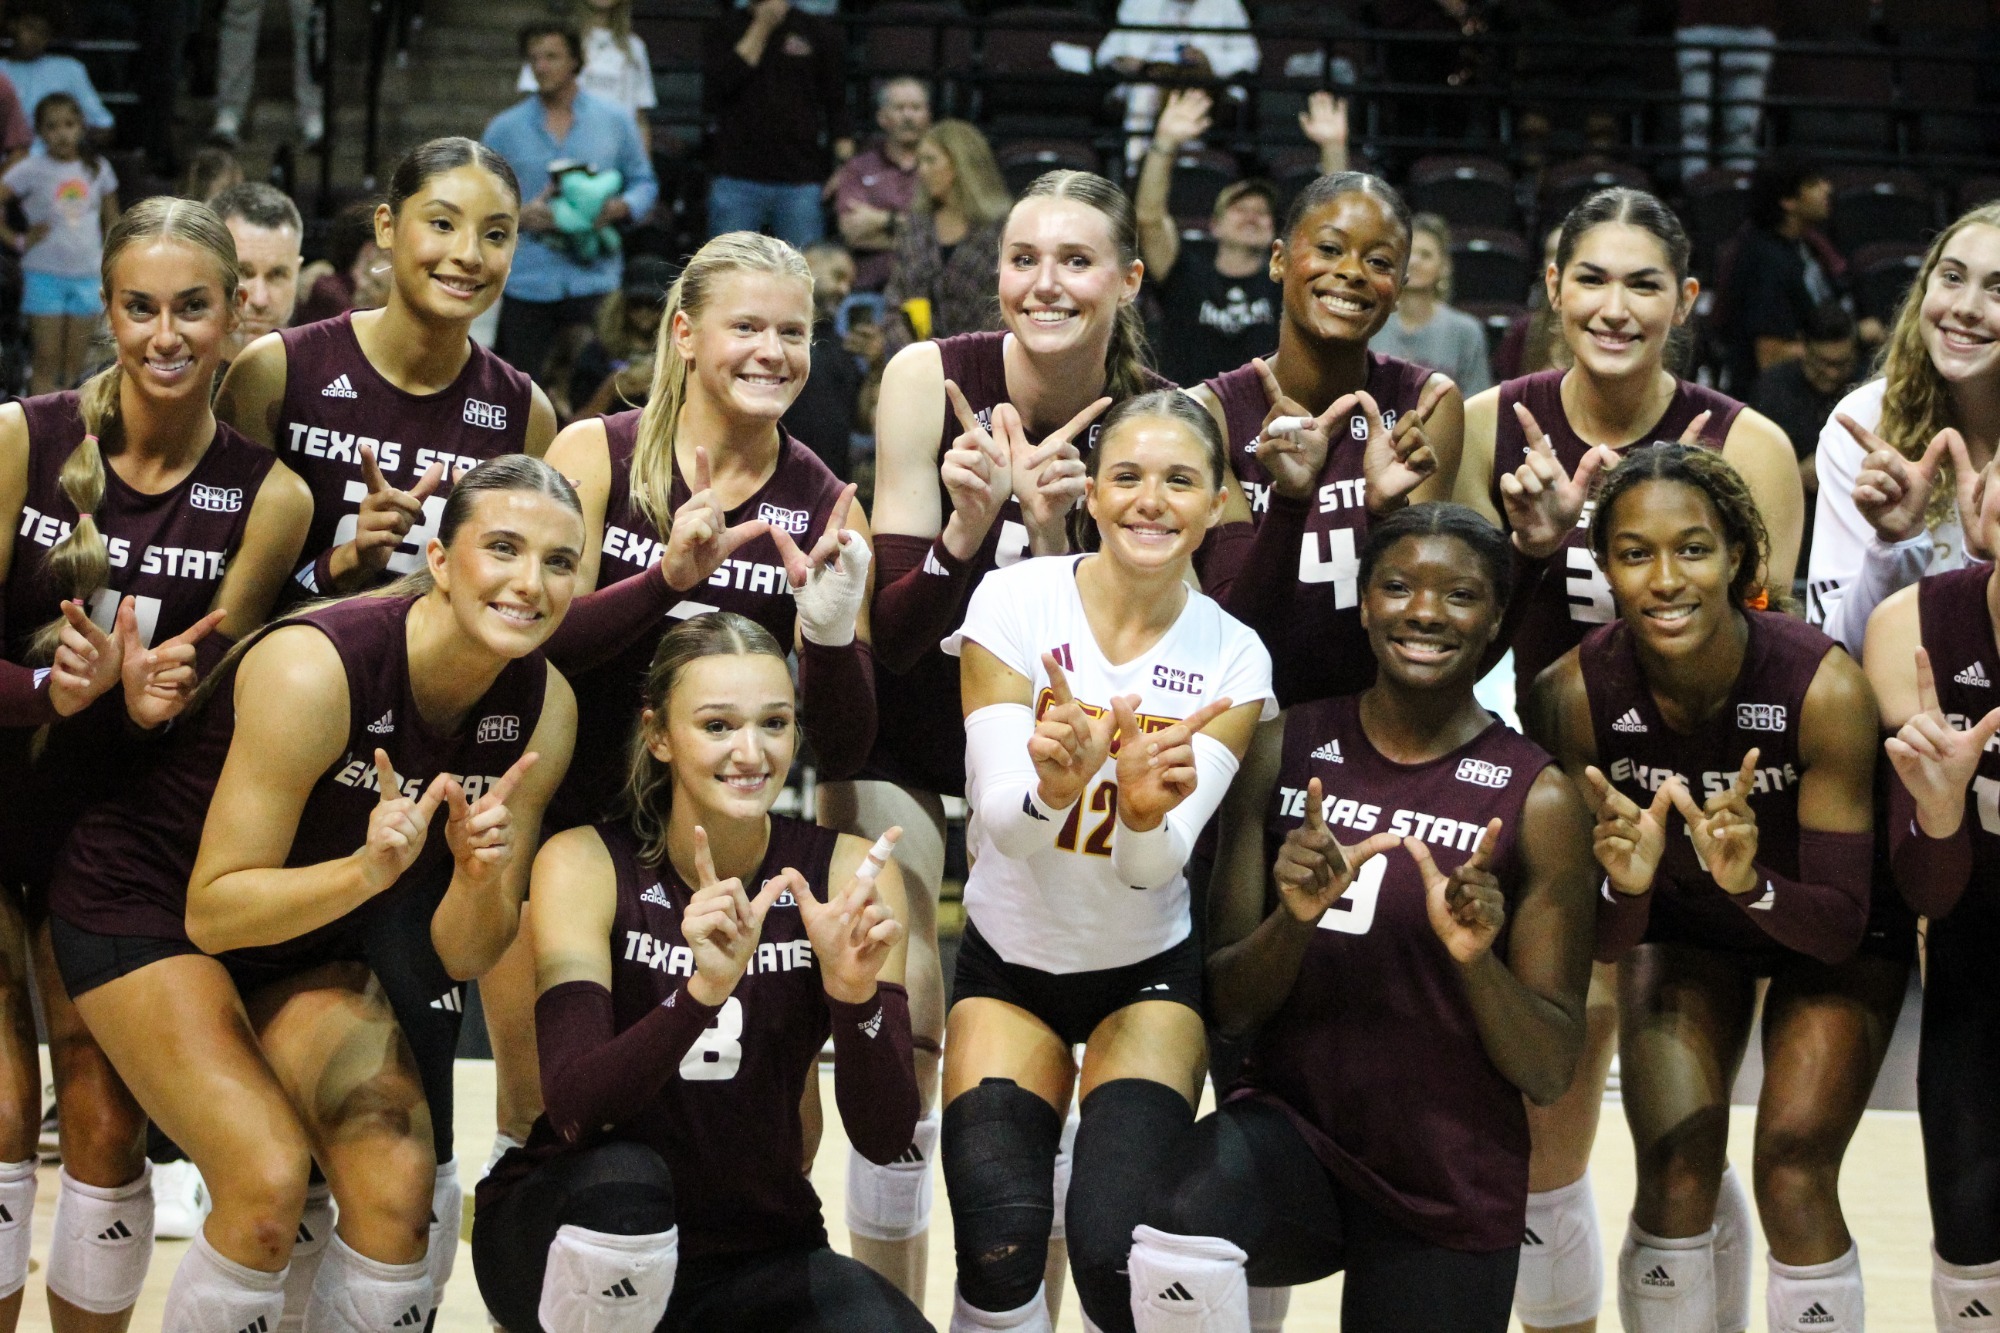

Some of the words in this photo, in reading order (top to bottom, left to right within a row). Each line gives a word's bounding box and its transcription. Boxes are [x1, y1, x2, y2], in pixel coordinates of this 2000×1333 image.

[321, 386, 358, 399] adidas
[463, 398, 507, 430] SBC
[289, 422, 402, 472] TEXAS
[190, 483, 243, 512] SBC
[708, 558, 794, 594] STAT
[1299, 528, 1361, 610] 4
[1152, 664, 1204, 695] SBC
[1954, 674, 1991, 688] adidas
[477, 715, 520, 743] SBC
[1612, 722, 1648, 733] adidas
[1736, 703, 1787, 732] SBC
[1310, 750, 1344, 764] adidas
[1455, 758, 1512, 788] SBC
[640, 892, 671, 909] adidas
[624, 931, 697, 977] TEXA
[679, 996, 743, 1081] 8
[1641, 1278, 1676, 1288] adidas
[1798, 1315, 1835, 1324] adidas
